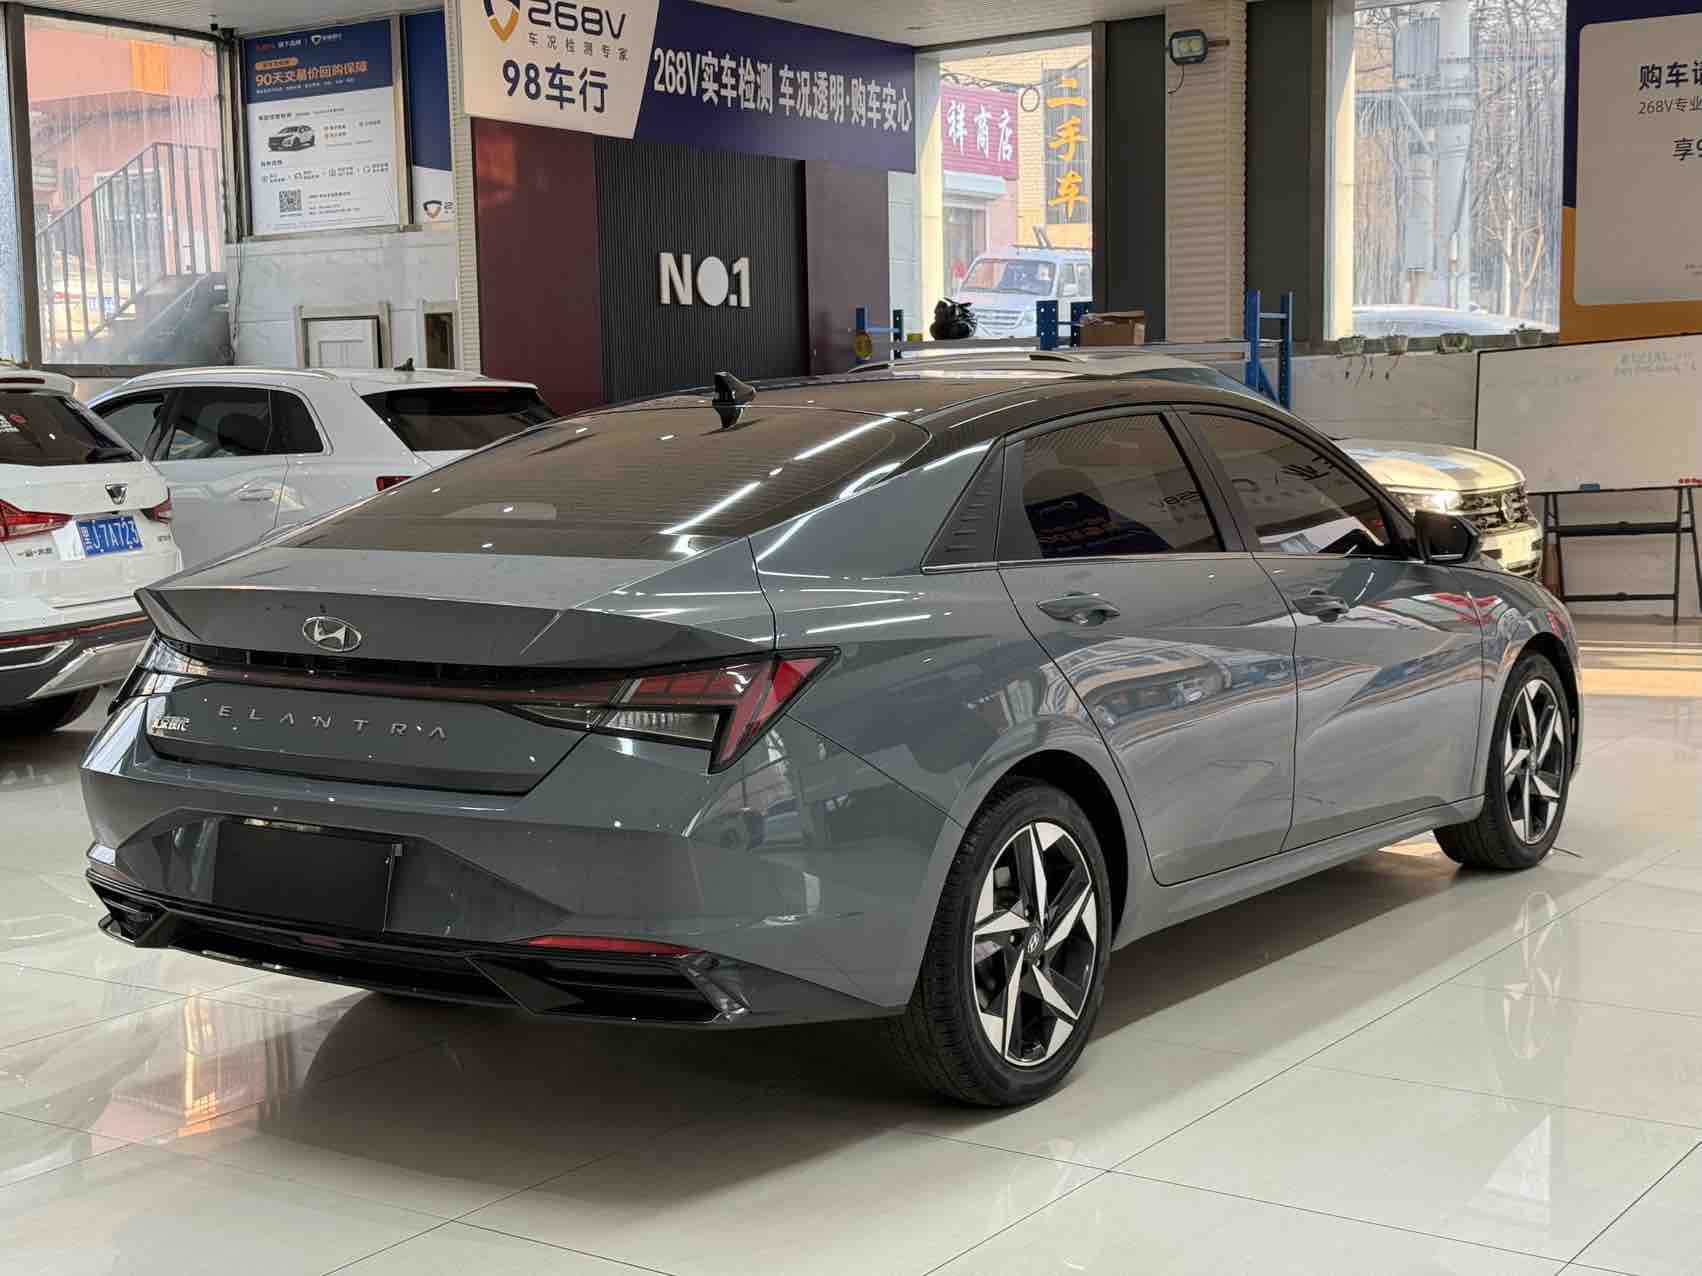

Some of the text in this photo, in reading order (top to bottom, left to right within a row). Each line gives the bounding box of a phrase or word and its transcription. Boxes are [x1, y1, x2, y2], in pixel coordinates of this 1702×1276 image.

[528, 0, 627, 39] 268V
[528, 31, 629, 61] 车况检测专家
[502, 59, 609, 114] 98车行
[654, 47, 774, 114] 268V实车检测
[946, 100, 1014, 162] 祥商店
[1046, 77, 1089, 218] 二手车
[659, 252, 751, 308] NO.1
[217, 703, 448, 740] ELANTRA
